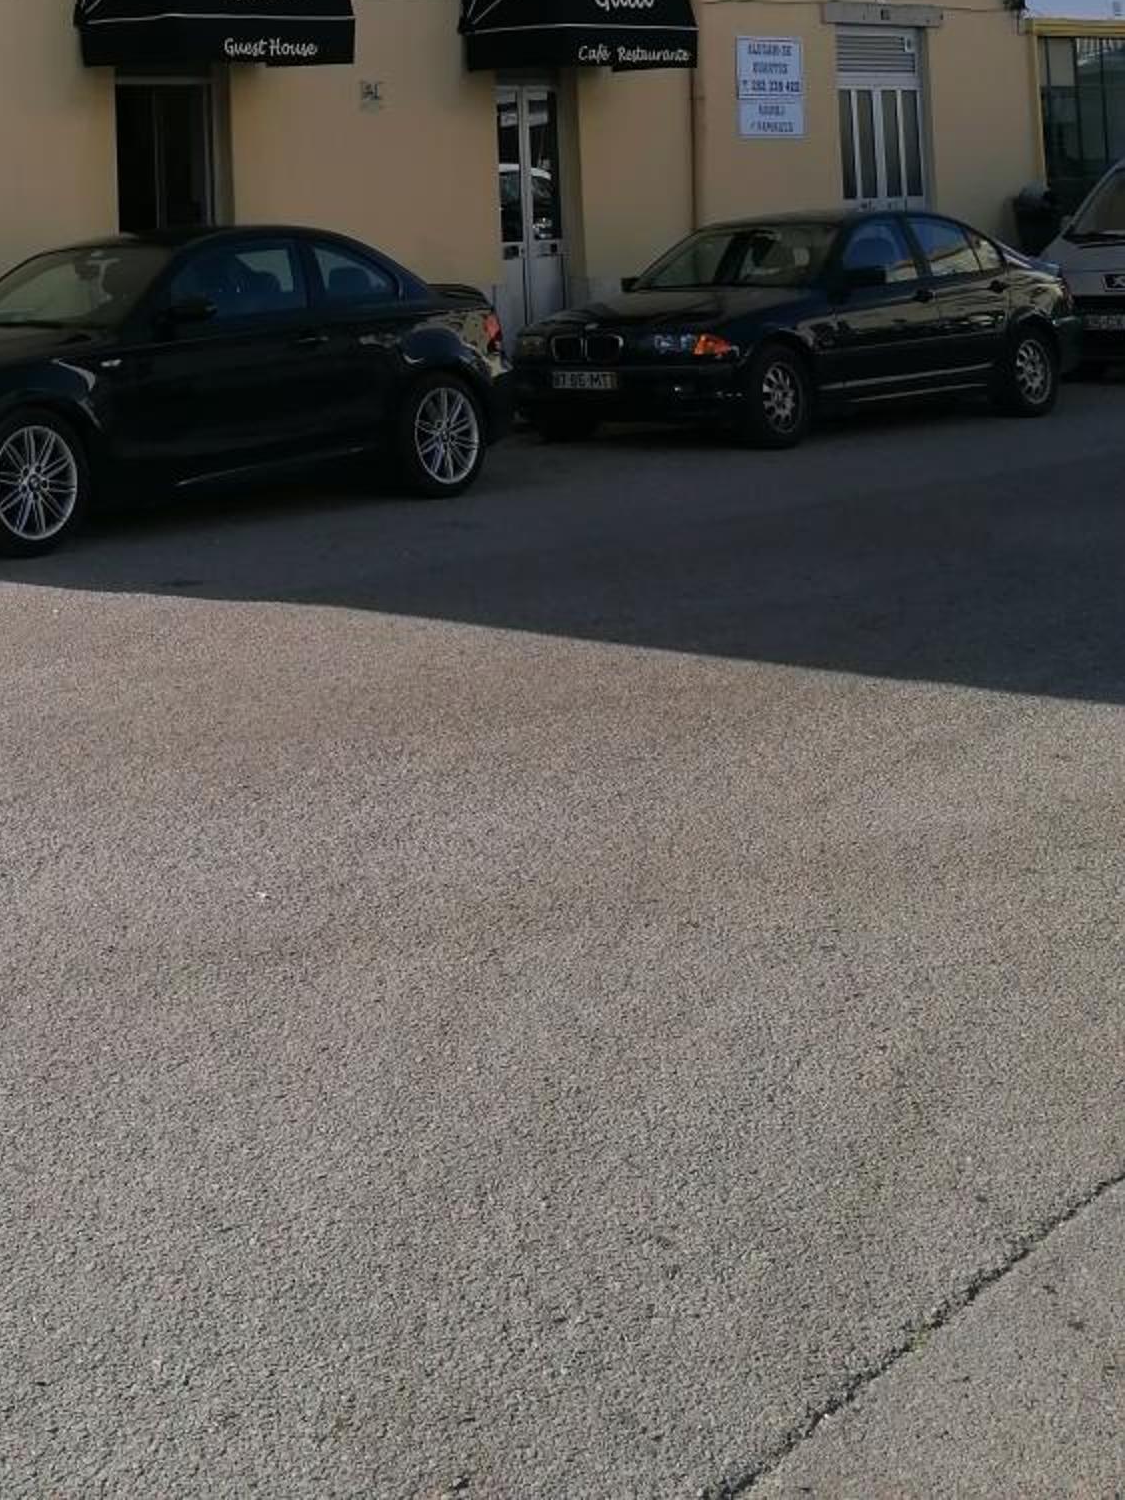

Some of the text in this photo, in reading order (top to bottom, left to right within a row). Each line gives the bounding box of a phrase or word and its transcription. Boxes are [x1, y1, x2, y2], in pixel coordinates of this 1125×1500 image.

[224, 37, 317, 57] Guest House
[578, 43, 690, 64] Café Restaurante
